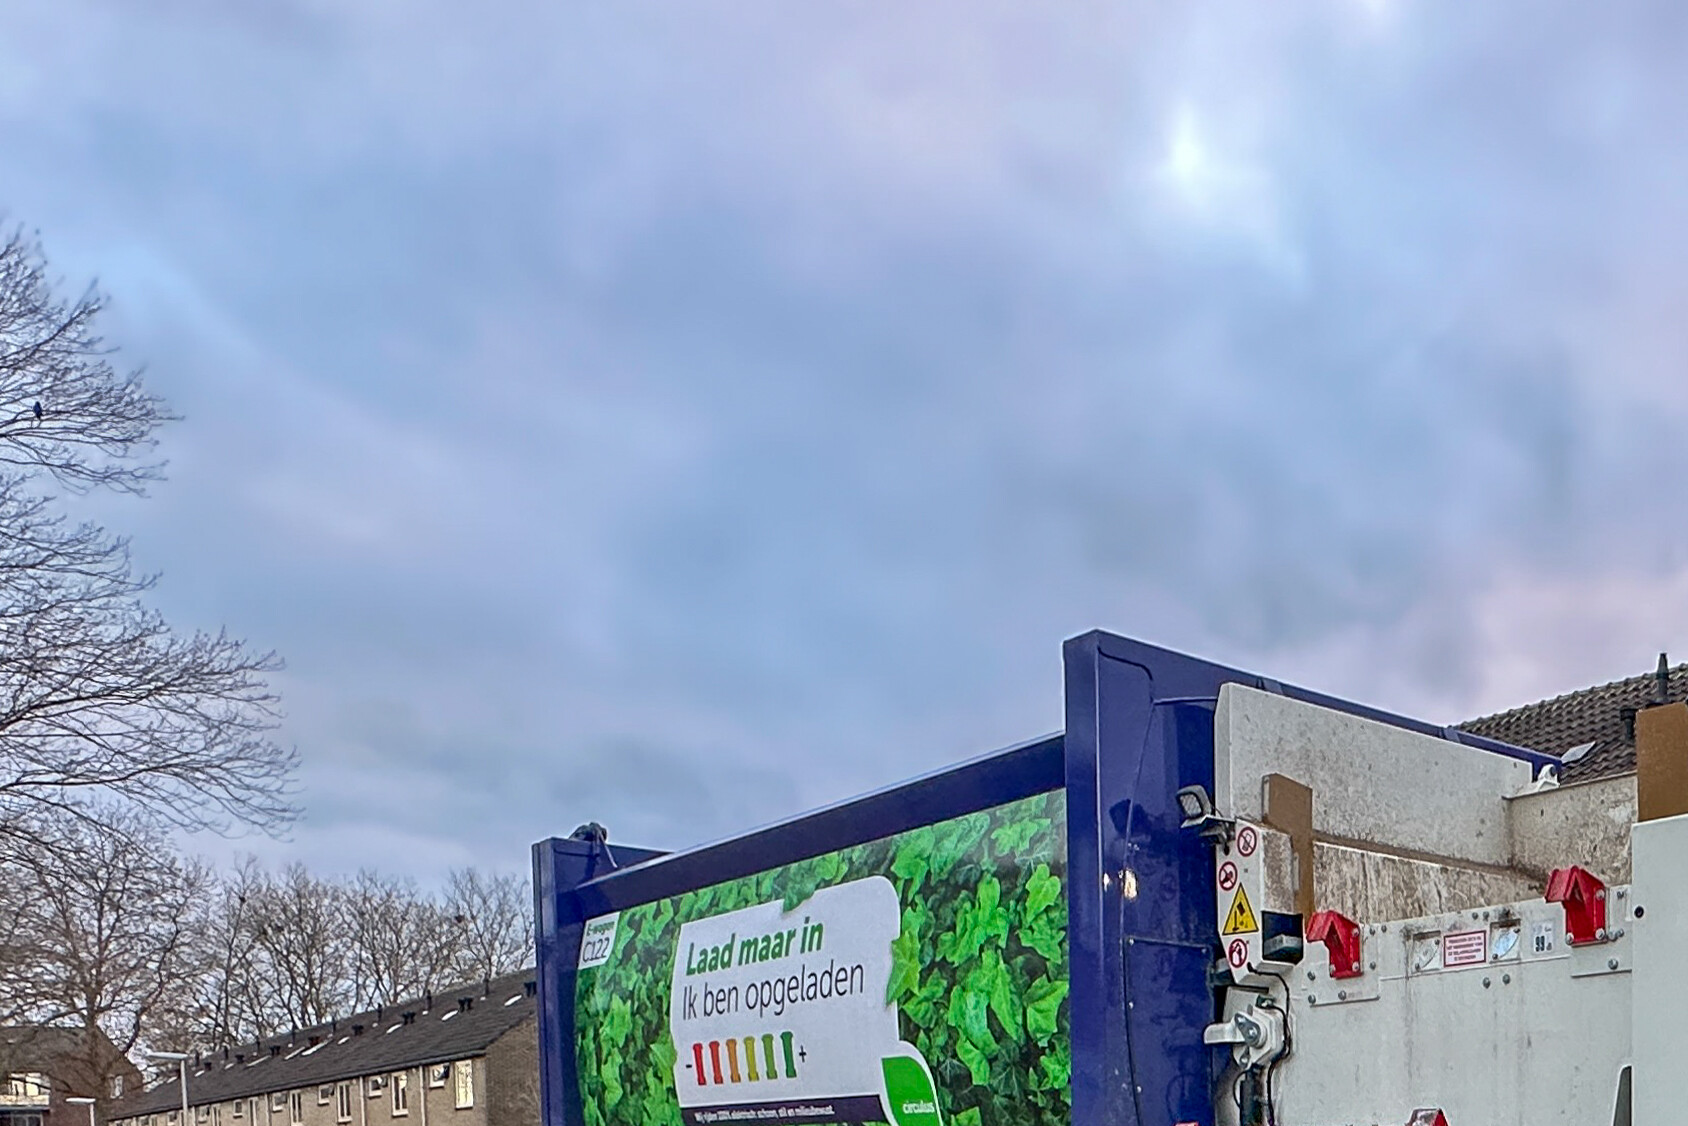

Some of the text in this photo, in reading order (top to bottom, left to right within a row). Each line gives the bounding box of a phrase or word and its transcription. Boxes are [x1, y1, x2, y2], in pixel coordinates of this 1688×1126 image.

[583, 937, 610, 963] C122
[686, 916, 824, 976] Laad maar in
[683, 959, 865, 1020] Ik ben opgeladen
[902, 1099, 935, 1114] circulus
